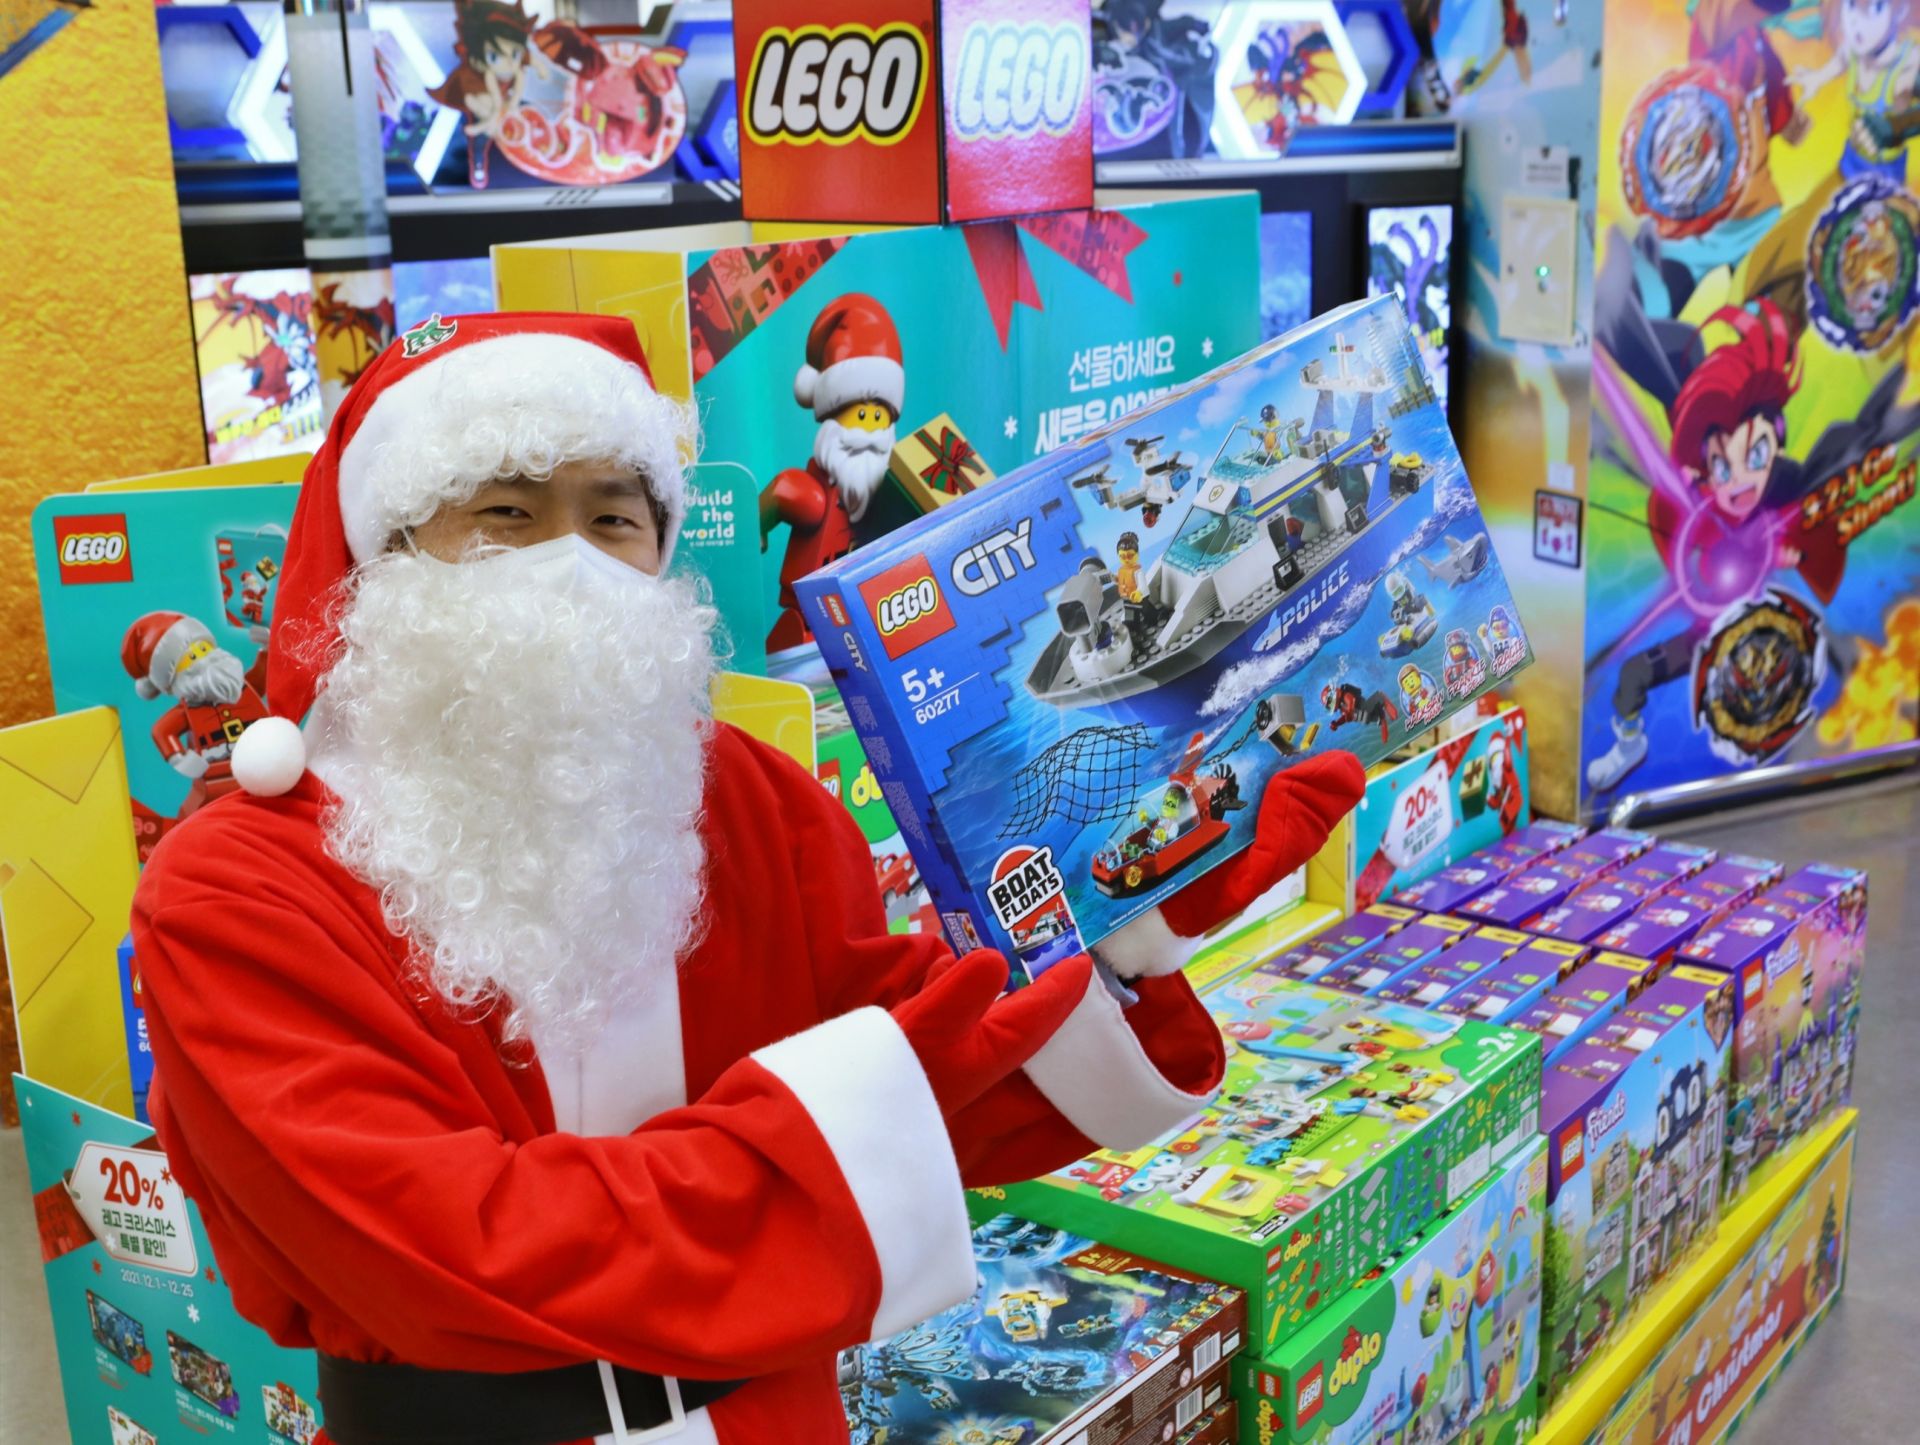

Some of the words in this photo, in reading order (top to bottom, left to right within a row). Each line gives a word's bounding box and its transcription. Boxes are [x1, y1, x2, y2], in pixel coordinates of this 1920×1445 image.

[748, 30, 924, 139] LEGO
[954, 23, 1084, 138] LEGO
[1068, 335, 1175, 393] 선물하세요
[682, 523, 735, 540] world
[702, 506, 734, 522] the
[62, 534, 125, 564] LEGO
[951, 517, 1037, 597] CITY
[878, 577, 937, 634] LEGO
[1282, 559, 1350, 638] POLICE
[901, 666, 945, 702] 5+
[915, 688, 961, 726] 60277
[1405, 785, 1439, 831] 20%
[992, 851, 1050, 910] BOAT
[1001, 872, 1060, 924] FLOATS
[100, 1157, 164, 1211] 20%
[102, 1208, 122, 1228] 레고
[124, 1211, 176, 1238] 크리스마스
[120, 1232, 140, 1254] 특별
[142, 1237, 167, 1258] 할인!
[1298, 1374, 1323, 1414] LEGO
[1328, 1332, 1382, 1397] duplo
